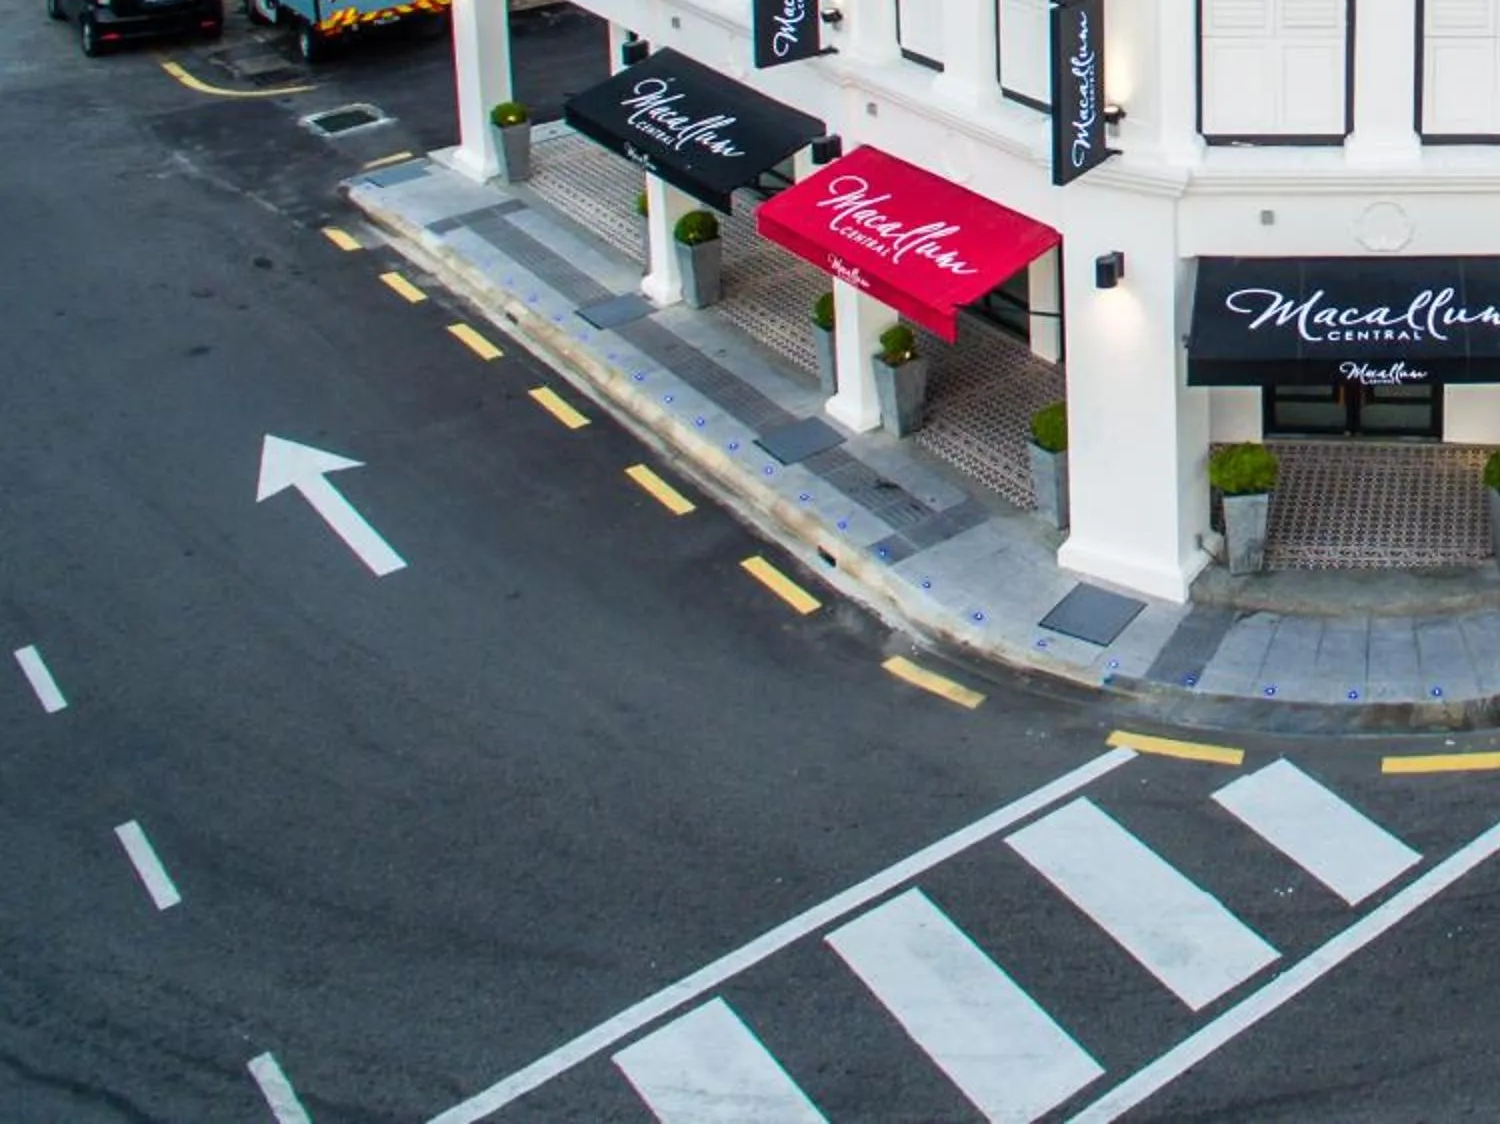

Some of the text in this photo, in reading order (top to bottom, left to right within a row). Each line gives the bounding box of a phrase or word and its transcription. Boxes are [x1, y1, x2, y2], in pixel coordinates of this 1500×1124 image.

[1070, 11, 1095, 167] Macallum
[620, 78, 745, 157] Macallum
[816, 175, 978, 275] Macallum
[838, 226, 891, 257] CENTRAL
[1327, 329, 1423, 341] CENTRAL
[1339, 361, 1428, 385] Macallum
